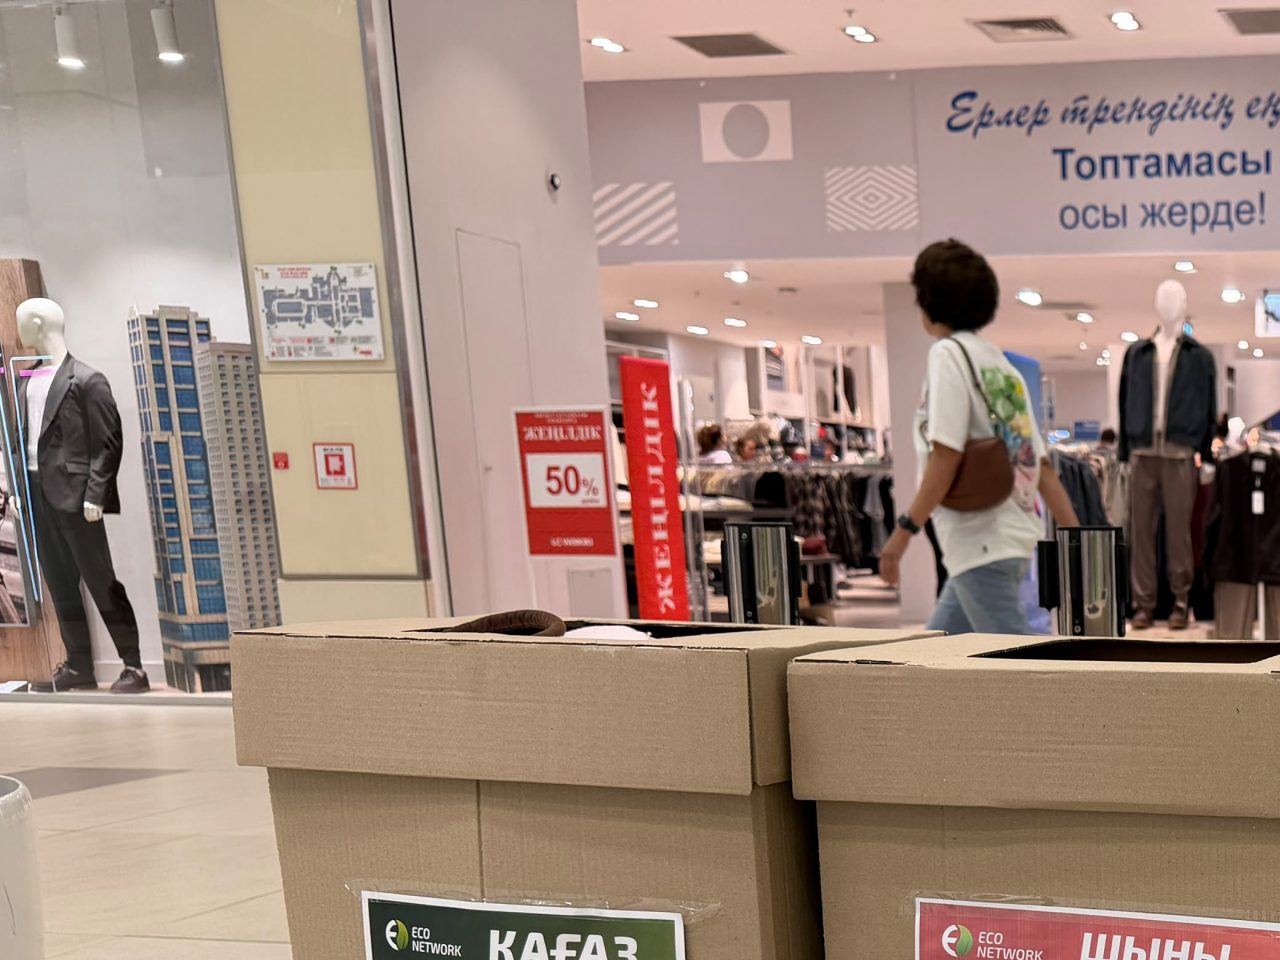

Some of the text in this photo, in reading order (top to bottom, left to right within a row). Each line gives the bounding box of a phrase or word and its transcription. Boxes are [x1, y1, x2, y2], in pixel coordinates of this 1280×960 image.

[946, 90, 1050, 139] Ерлер
[1060, 92, 1235, 136] трендінің
[1052, 148, 1272, 180] Топтамасы
[1059, 192, 1266, 234] осы жерде!
[547, 465, 599, 496] 50%
[412, 926, 431, 940] ECO
[412, 940, 462, 957] NETWORK
[978, 932, 1003, 945] ECO
